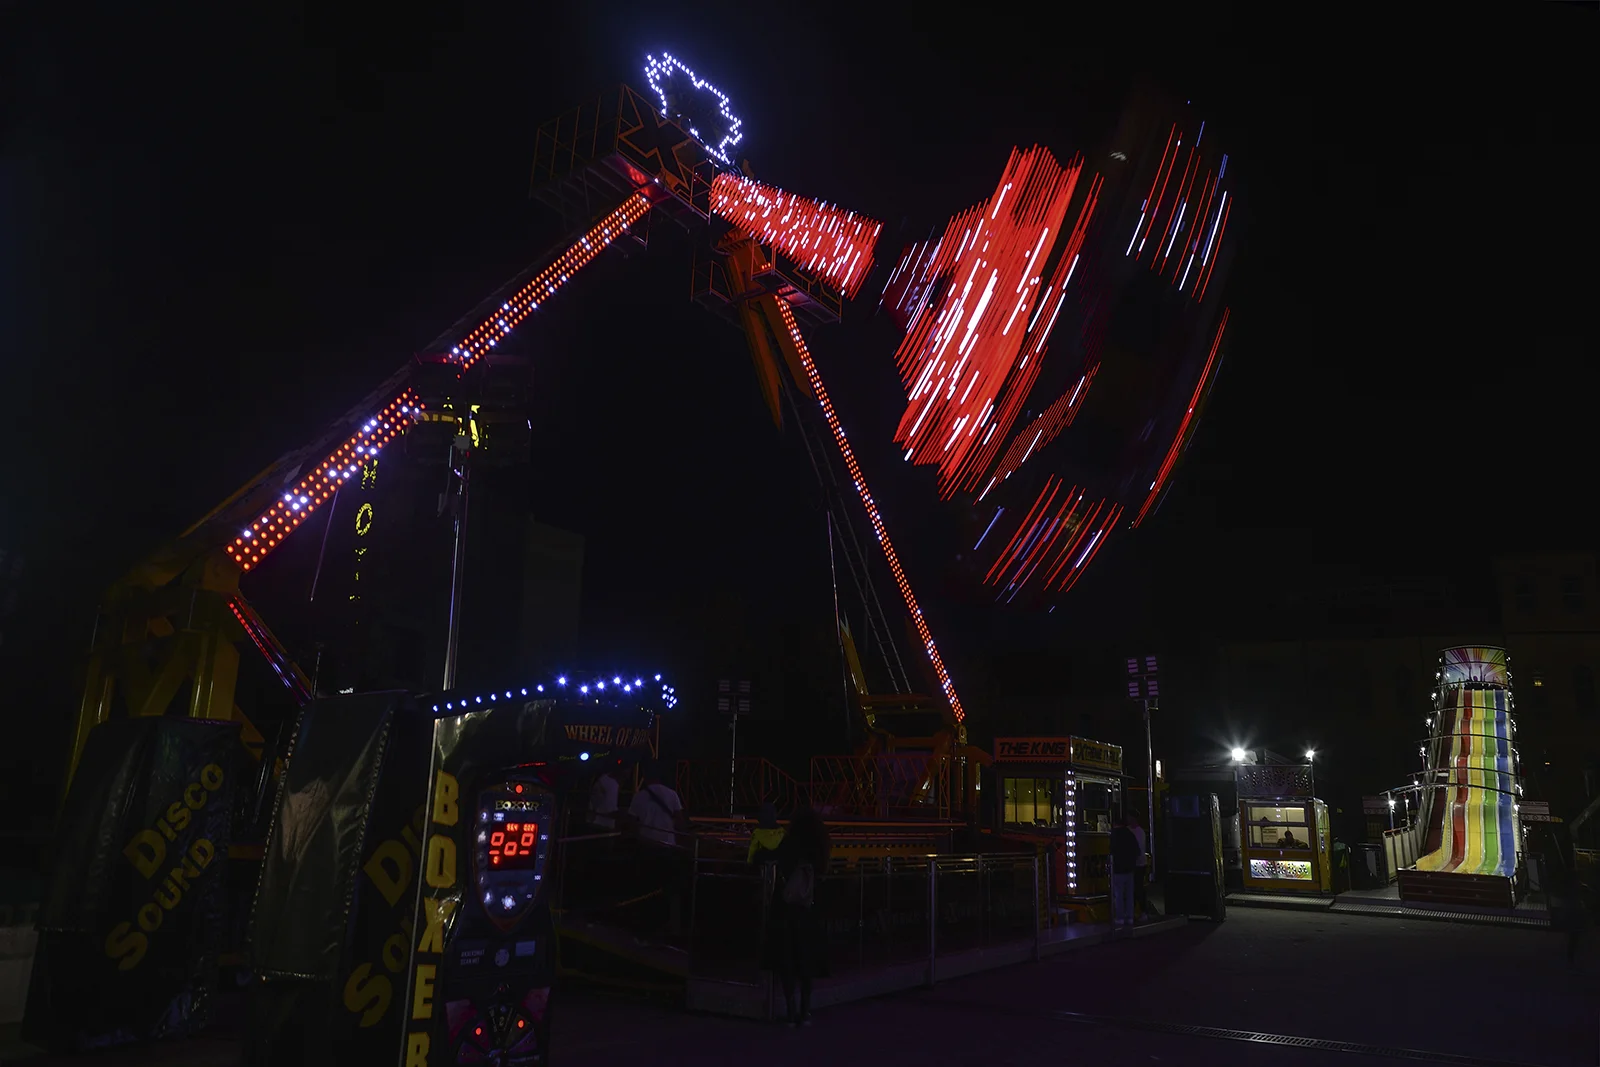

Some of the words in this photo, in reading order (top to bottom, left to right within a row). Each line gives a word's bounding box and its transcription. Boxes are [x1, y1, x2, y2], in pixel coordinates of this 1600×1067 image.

[564, 724, 613, 745] WHEEL
[999, 742, 1029, 755] THE
[1030, 742, 1067, 755] KING
[404, 769, 459, 1067] BOXER
